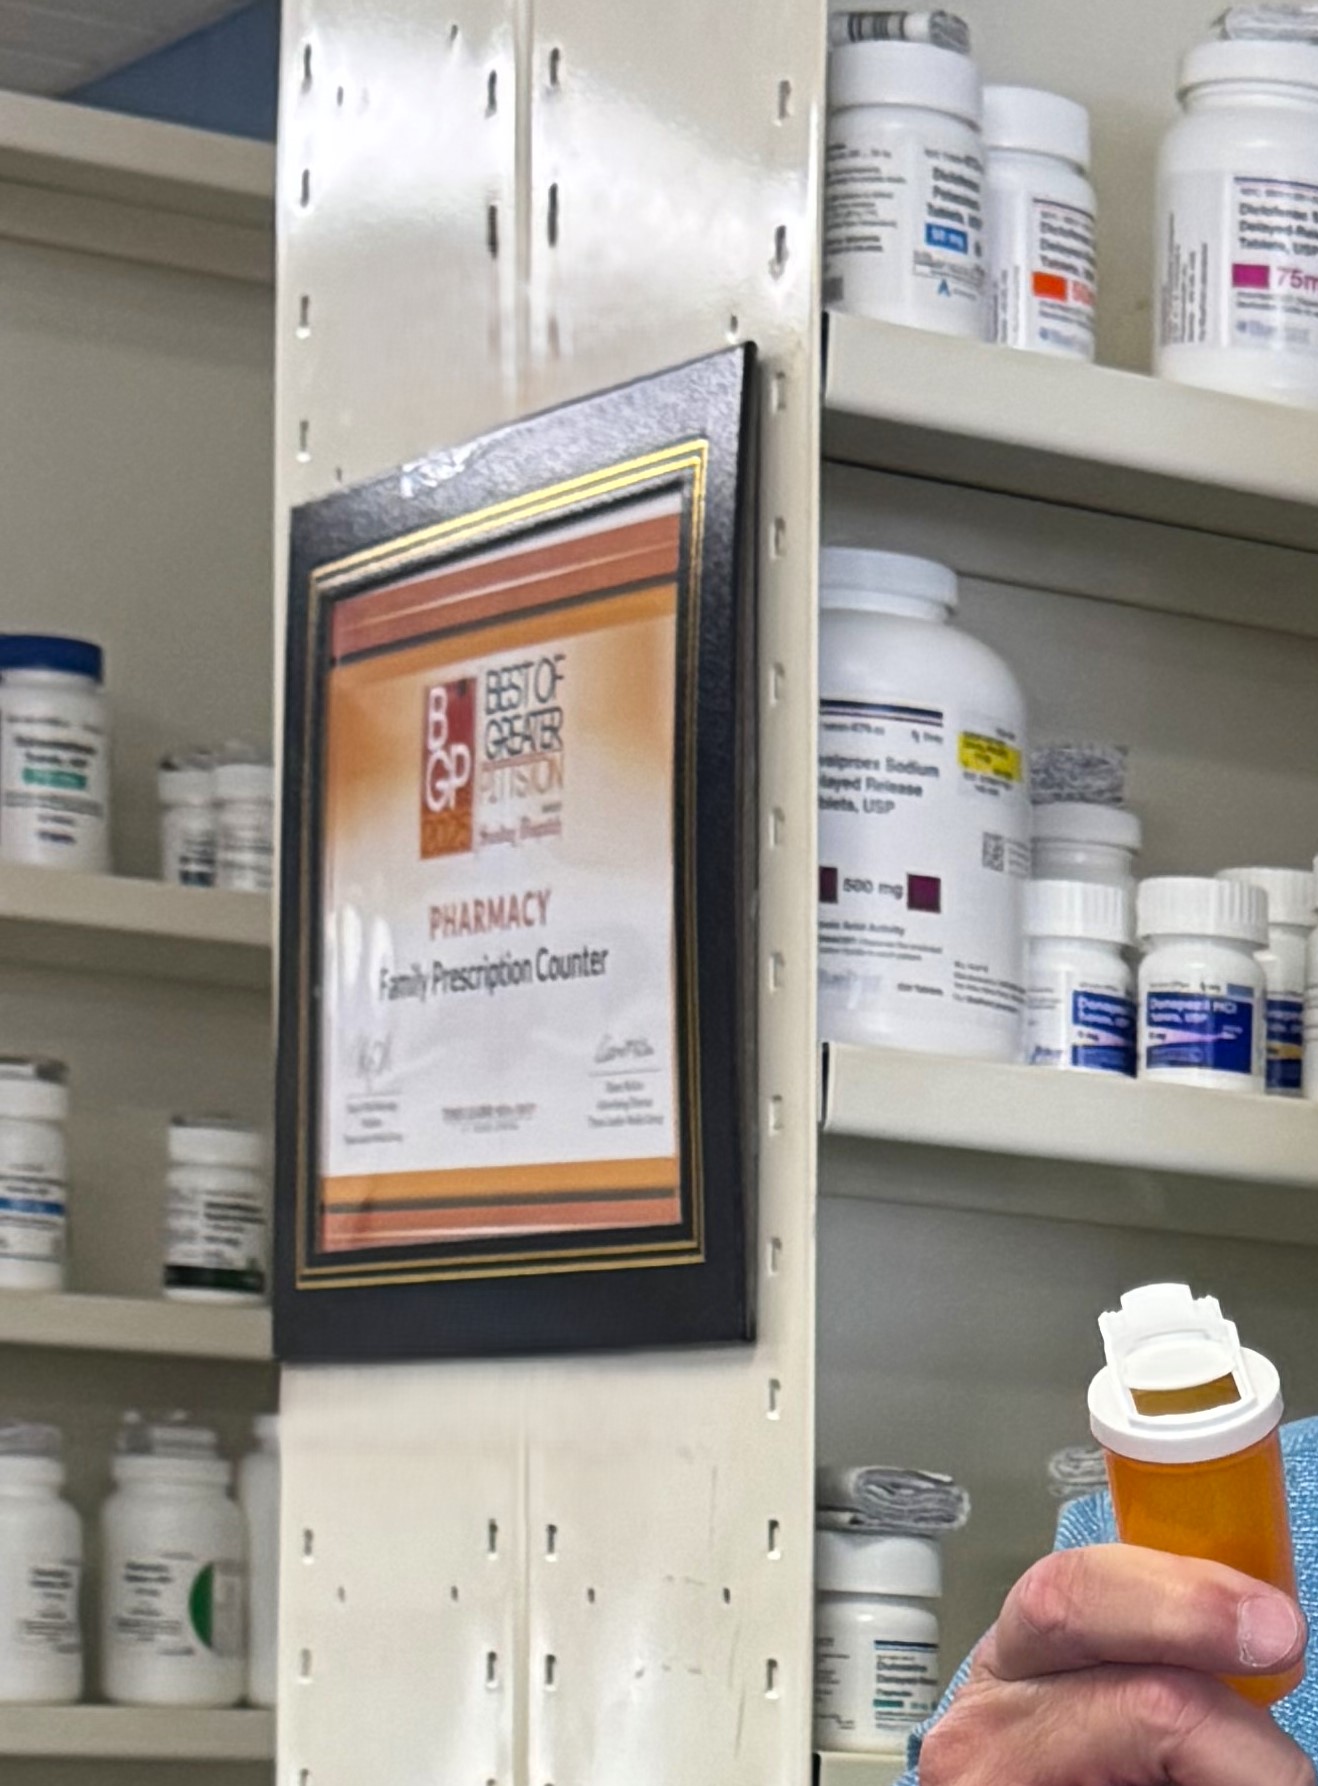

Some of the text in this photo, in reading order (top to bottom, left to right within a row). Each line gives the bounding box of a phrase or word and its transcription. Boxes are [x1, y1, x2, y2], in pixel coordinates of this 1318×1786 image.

[535, 653, 566, 704] OF
[484, 706, 564, 761] GREATER
[885, 756, 940, 778] Sodium
[865, 776, 923, 797] Release
[863, 798, 896, 814] USP
[878, 883, 904, 900] mg
[427, 889, 553, 942] PHARMACY
[379, 945, 610, 1003] Family Prescription Counter
